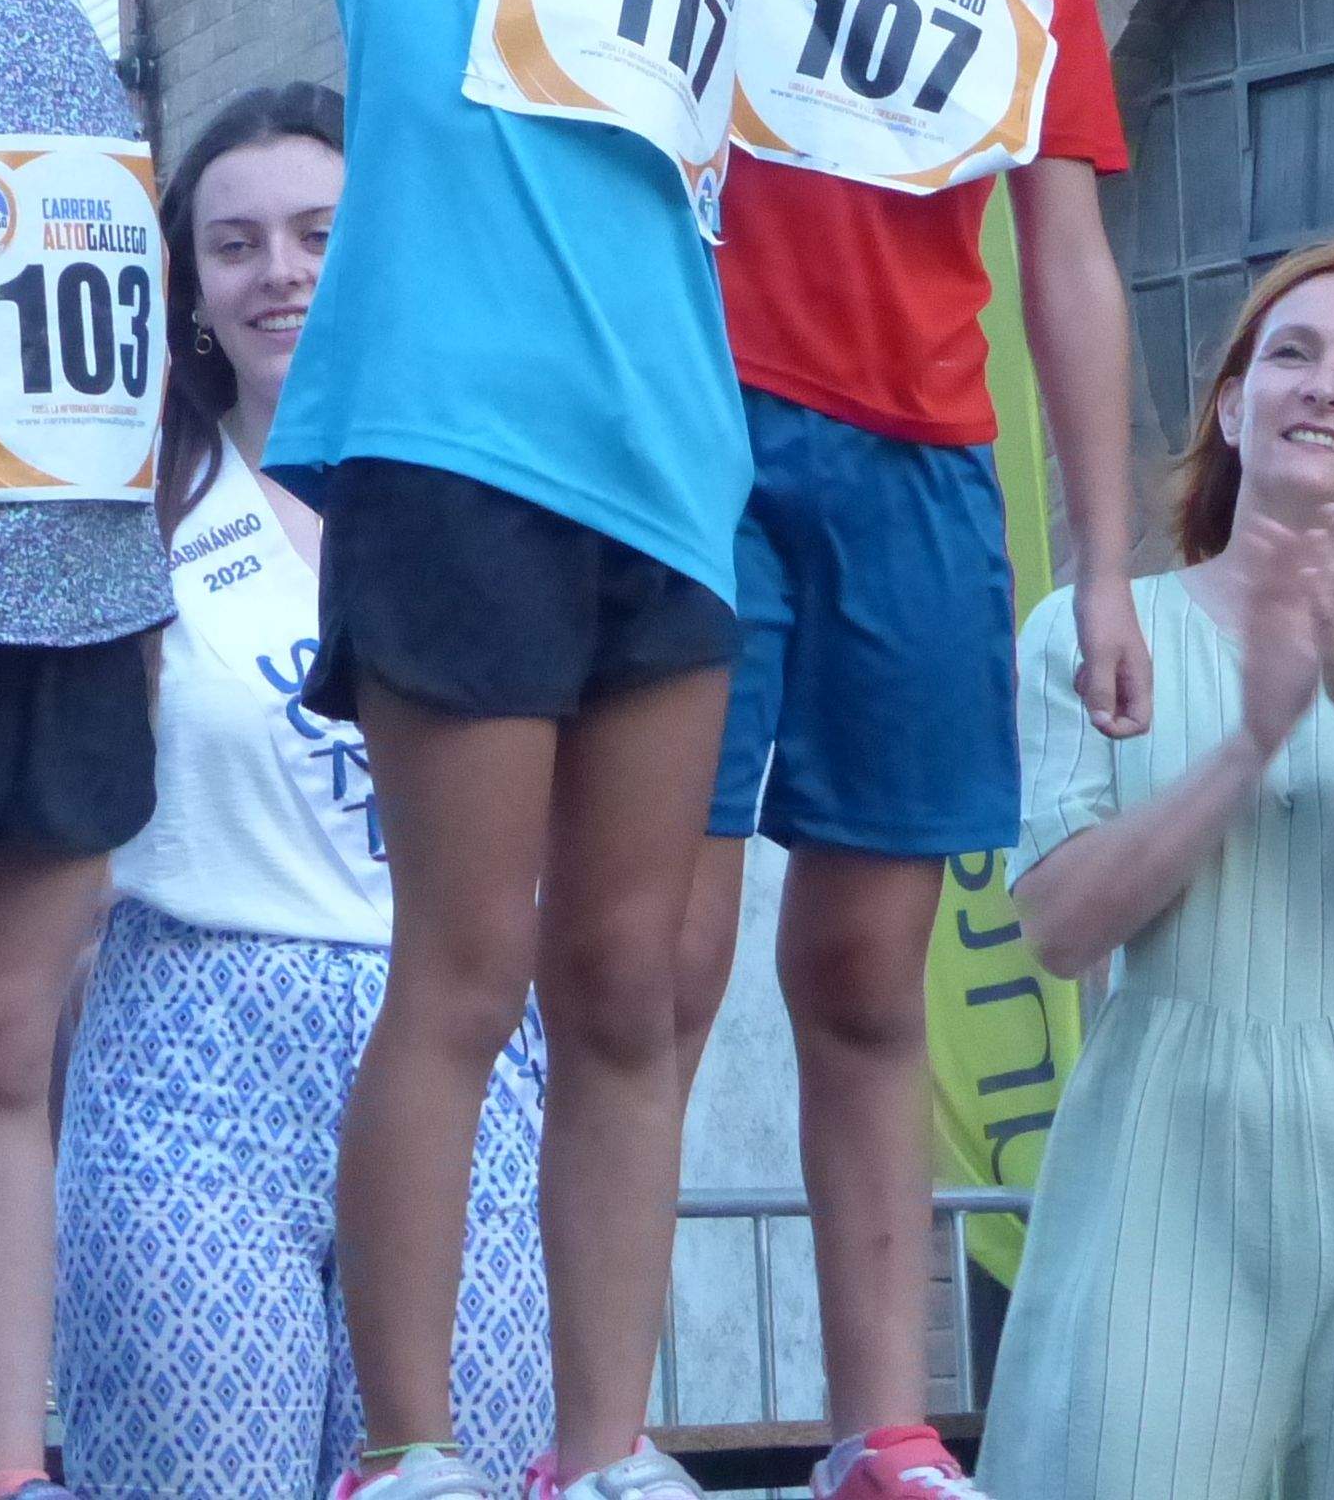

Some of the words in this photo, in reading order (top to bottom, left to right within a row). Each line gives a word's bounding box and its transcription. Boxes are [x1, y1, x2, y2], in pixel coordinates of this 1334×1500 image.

[41, 198, 113, 222] CARRERAS
[42, 222, 148, 255] ALTOGALLEGO
[203, 553, 263, 594] 2023
